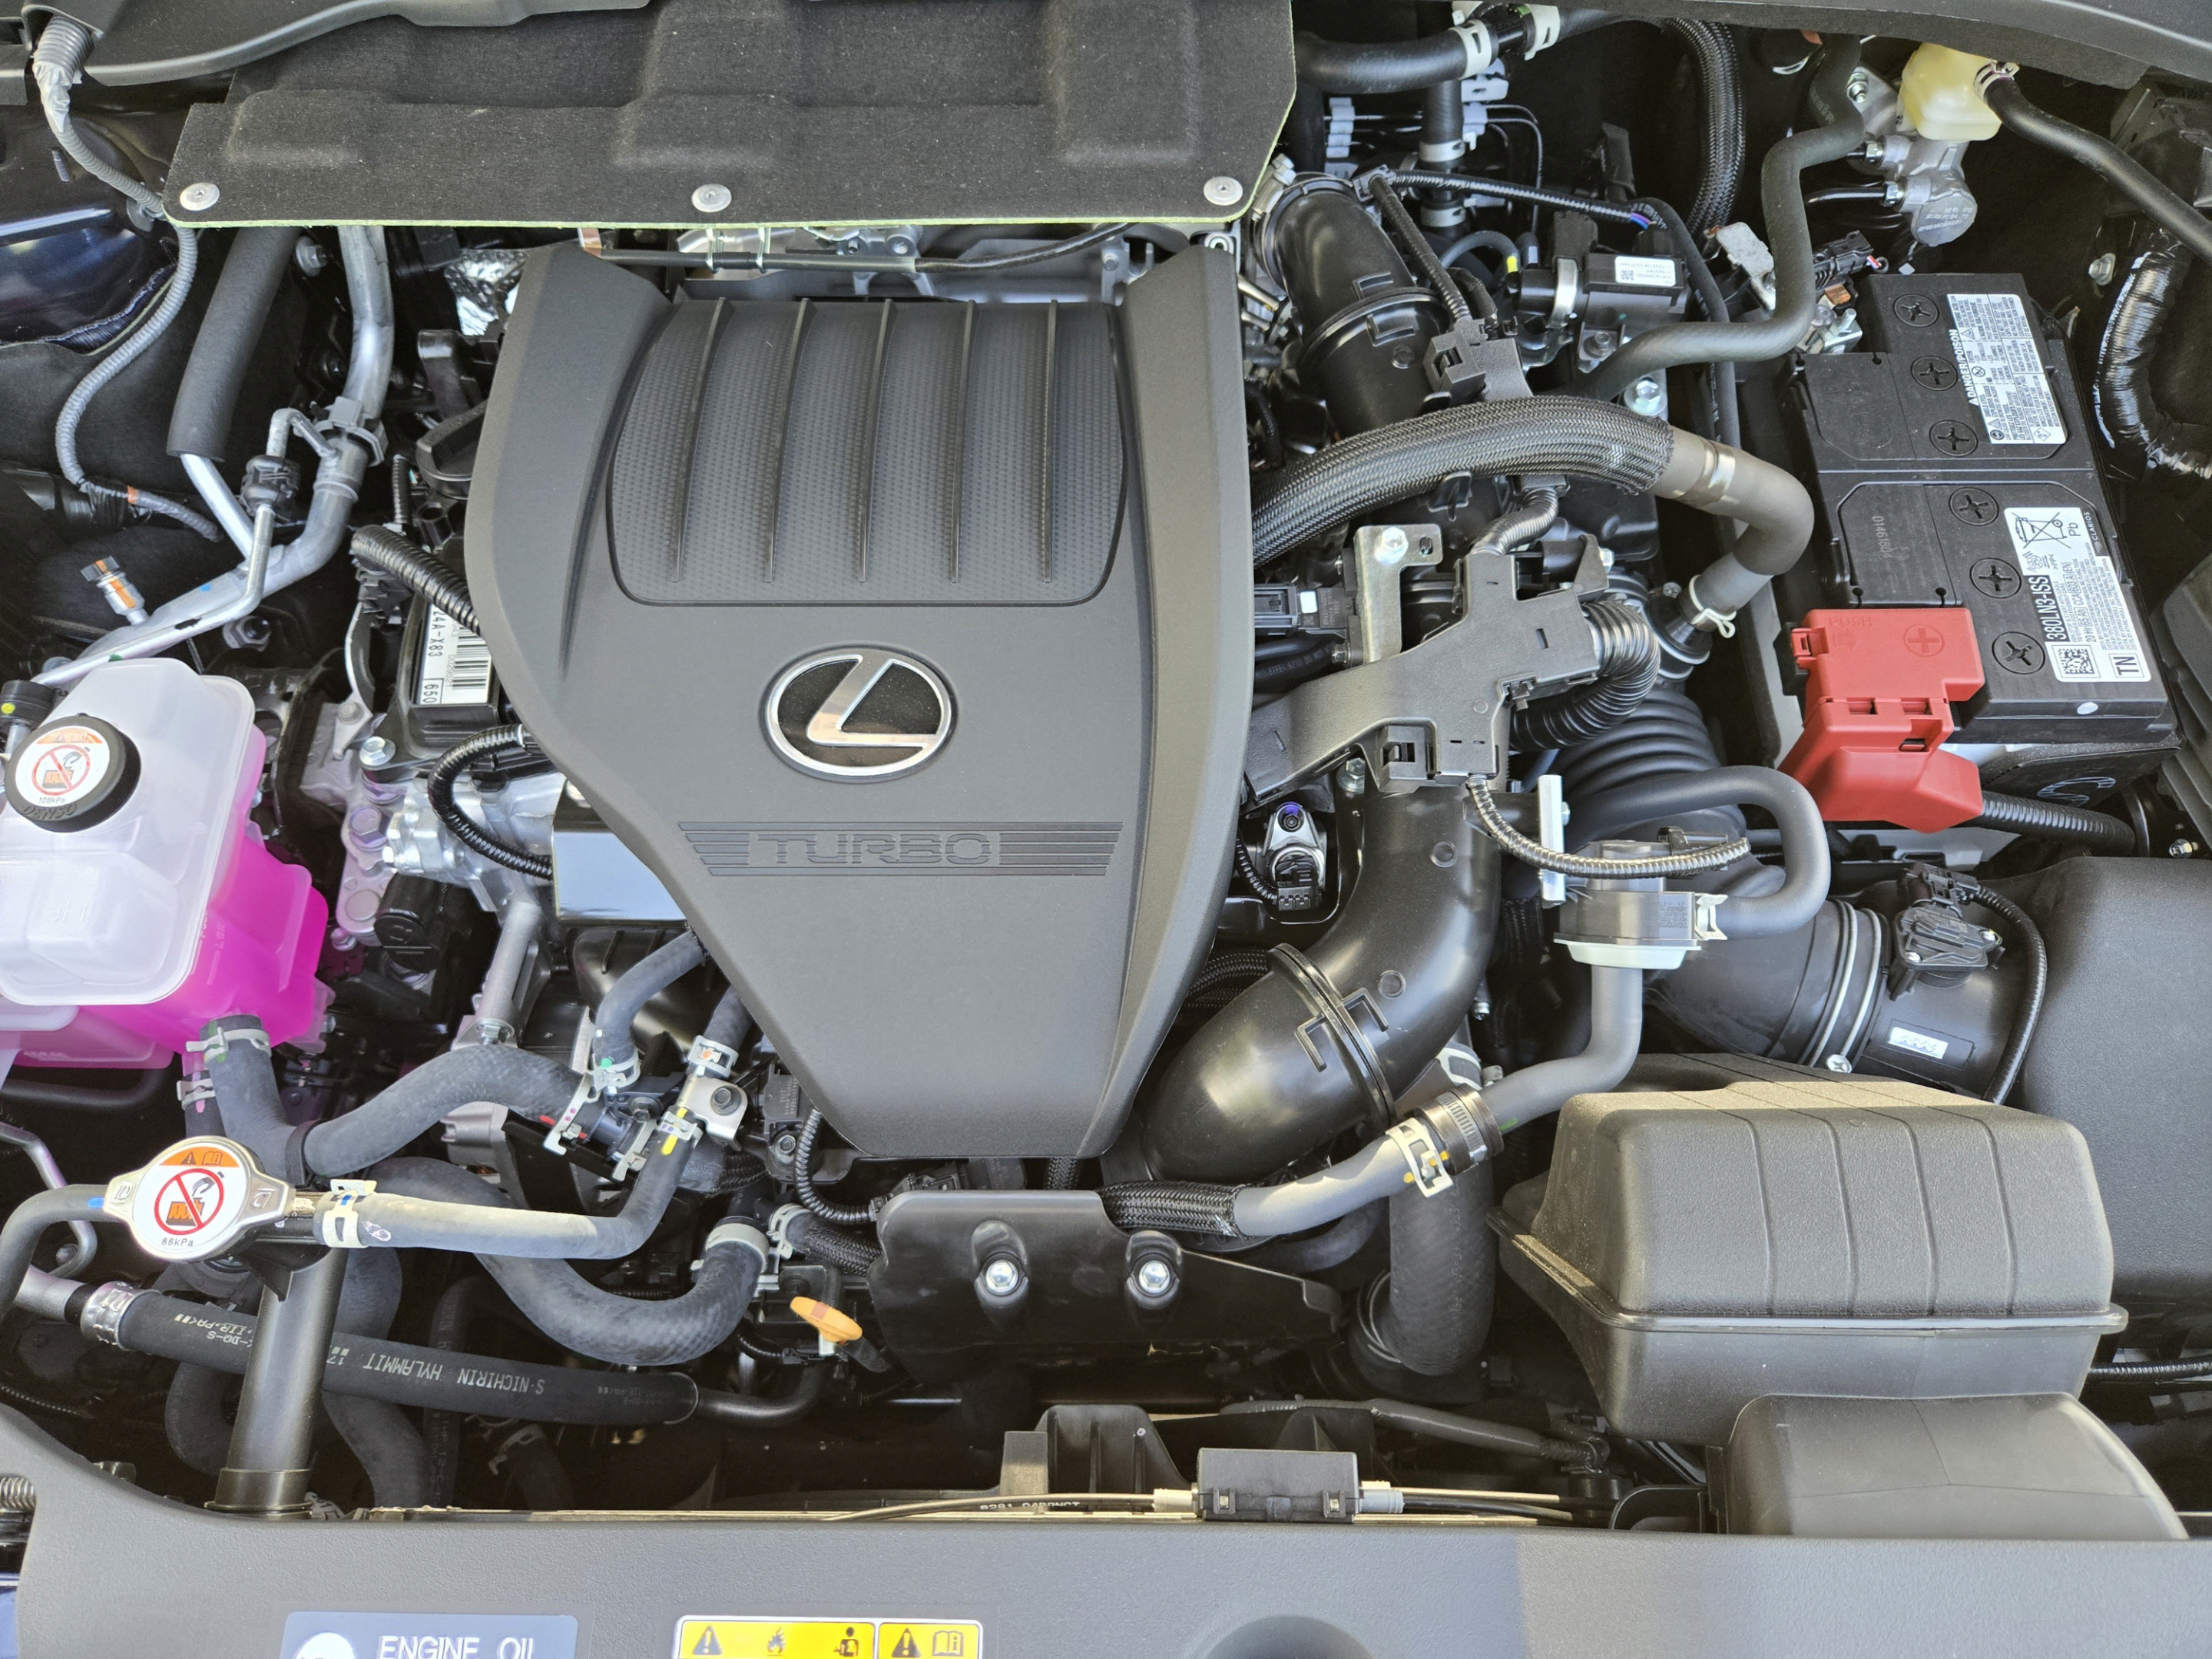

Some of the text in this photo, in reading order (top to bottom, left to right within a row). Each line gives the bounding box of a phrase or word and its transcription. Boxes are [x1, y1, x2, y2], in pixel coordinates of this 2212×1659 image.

[1947, 329, 1977, 397] DANGER/POISON
[2065, 522, 2081, 536] Pb
[2082, 511, 2098, 541] CLARIOS
[2066, 581, 2079, 591] 603
[2026, 576, 2068, 640] 380LN3-ISS
[2070, 593, 2084, 605] CCA
[2075, 608, 2088, 617] Ah
[2111, 655, 2141, 675] TN
[422, 683, 439, 704] 650
[22, 803, 77, 820] DENSO
[756, 833, 992, 865] TURBO
[161, 1237, 194, 1247] 88kPa
[361, 1351, 443, 1381] HYLAMMIT
[379, 1634, 480, 1659] ENGINE
